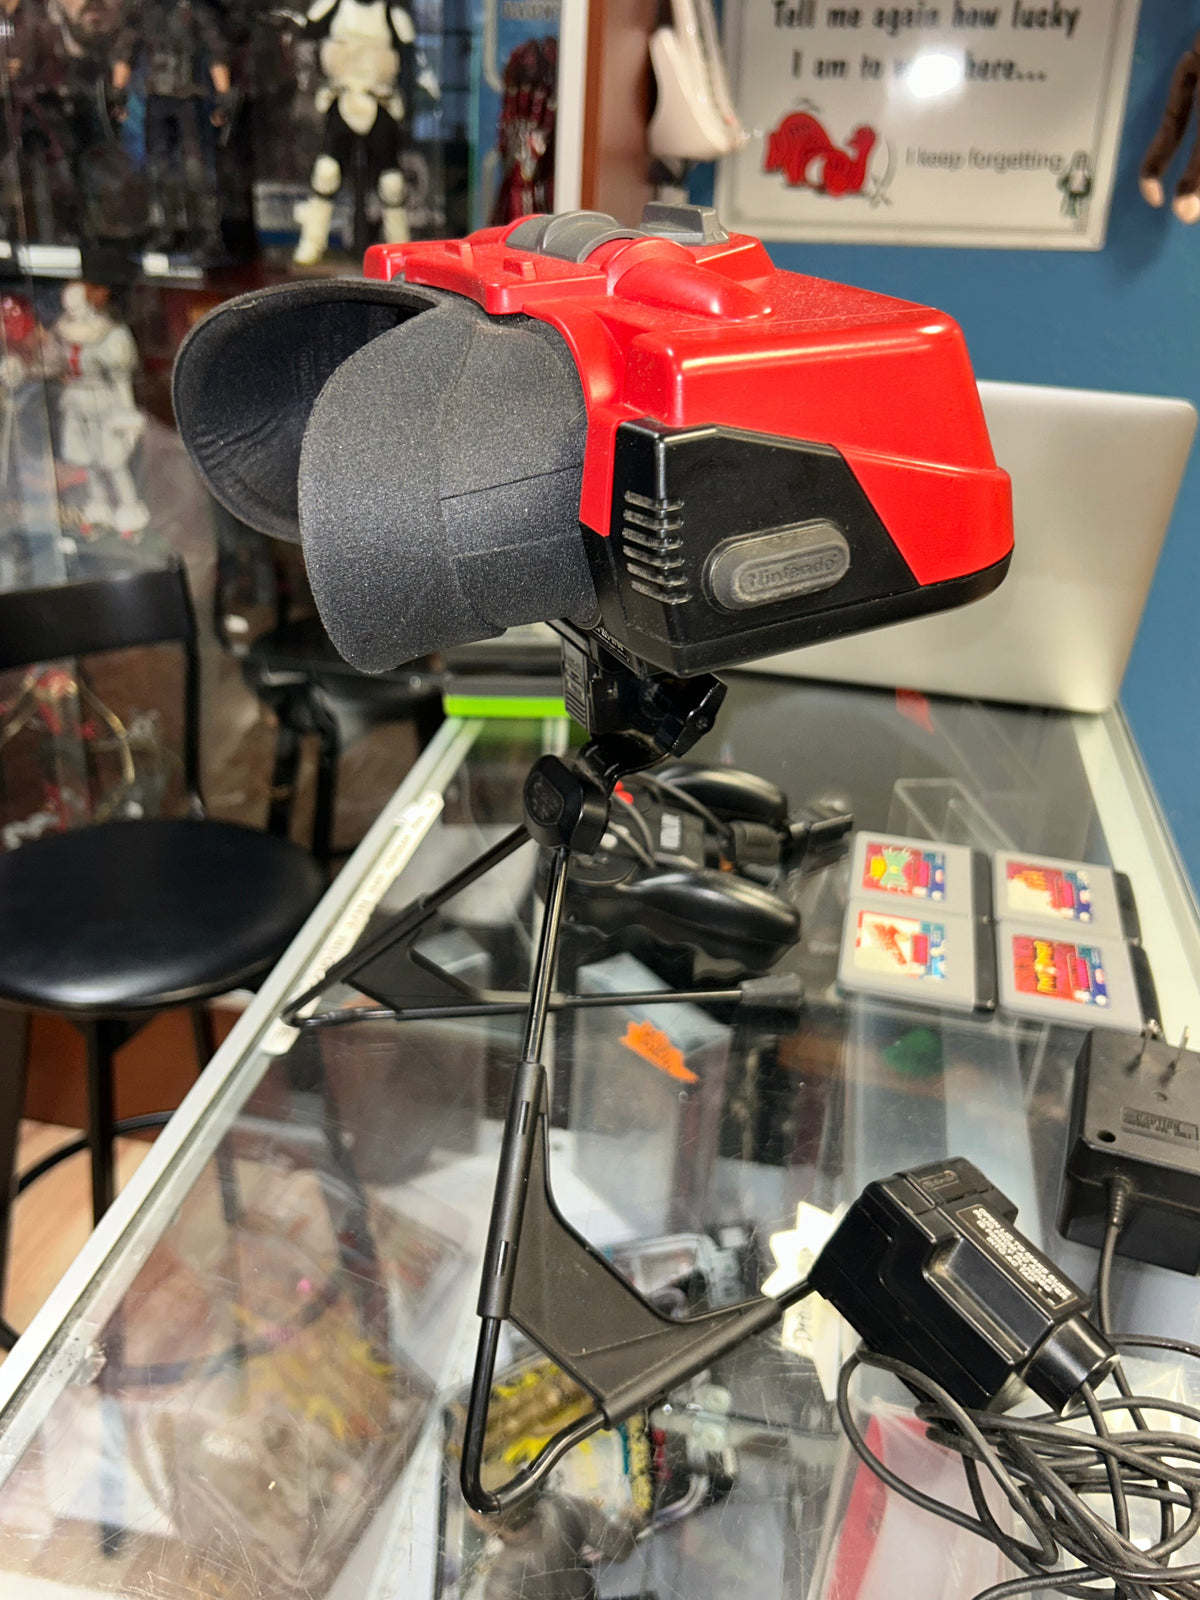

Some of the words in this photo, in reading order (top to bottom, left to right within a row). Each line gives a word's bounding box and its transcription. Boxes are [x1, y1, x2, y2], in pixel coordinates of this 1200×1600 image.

[773, 0, 815, 28] Tell
[827, 8, 861, 28] me
[873, 0, 938, 36] again
[952, 0, 998, 28] how
[1011, 0, 1080, 38] lucky
[792, 49, 801, 79] I
[813, 57, 847, 79] am
[860, 53, 883, 79] to
[917, 147, 963, 172] keep
[748, 555, 835, 587] Nintendo
[1012, 1240, 1026, 1253] TO
